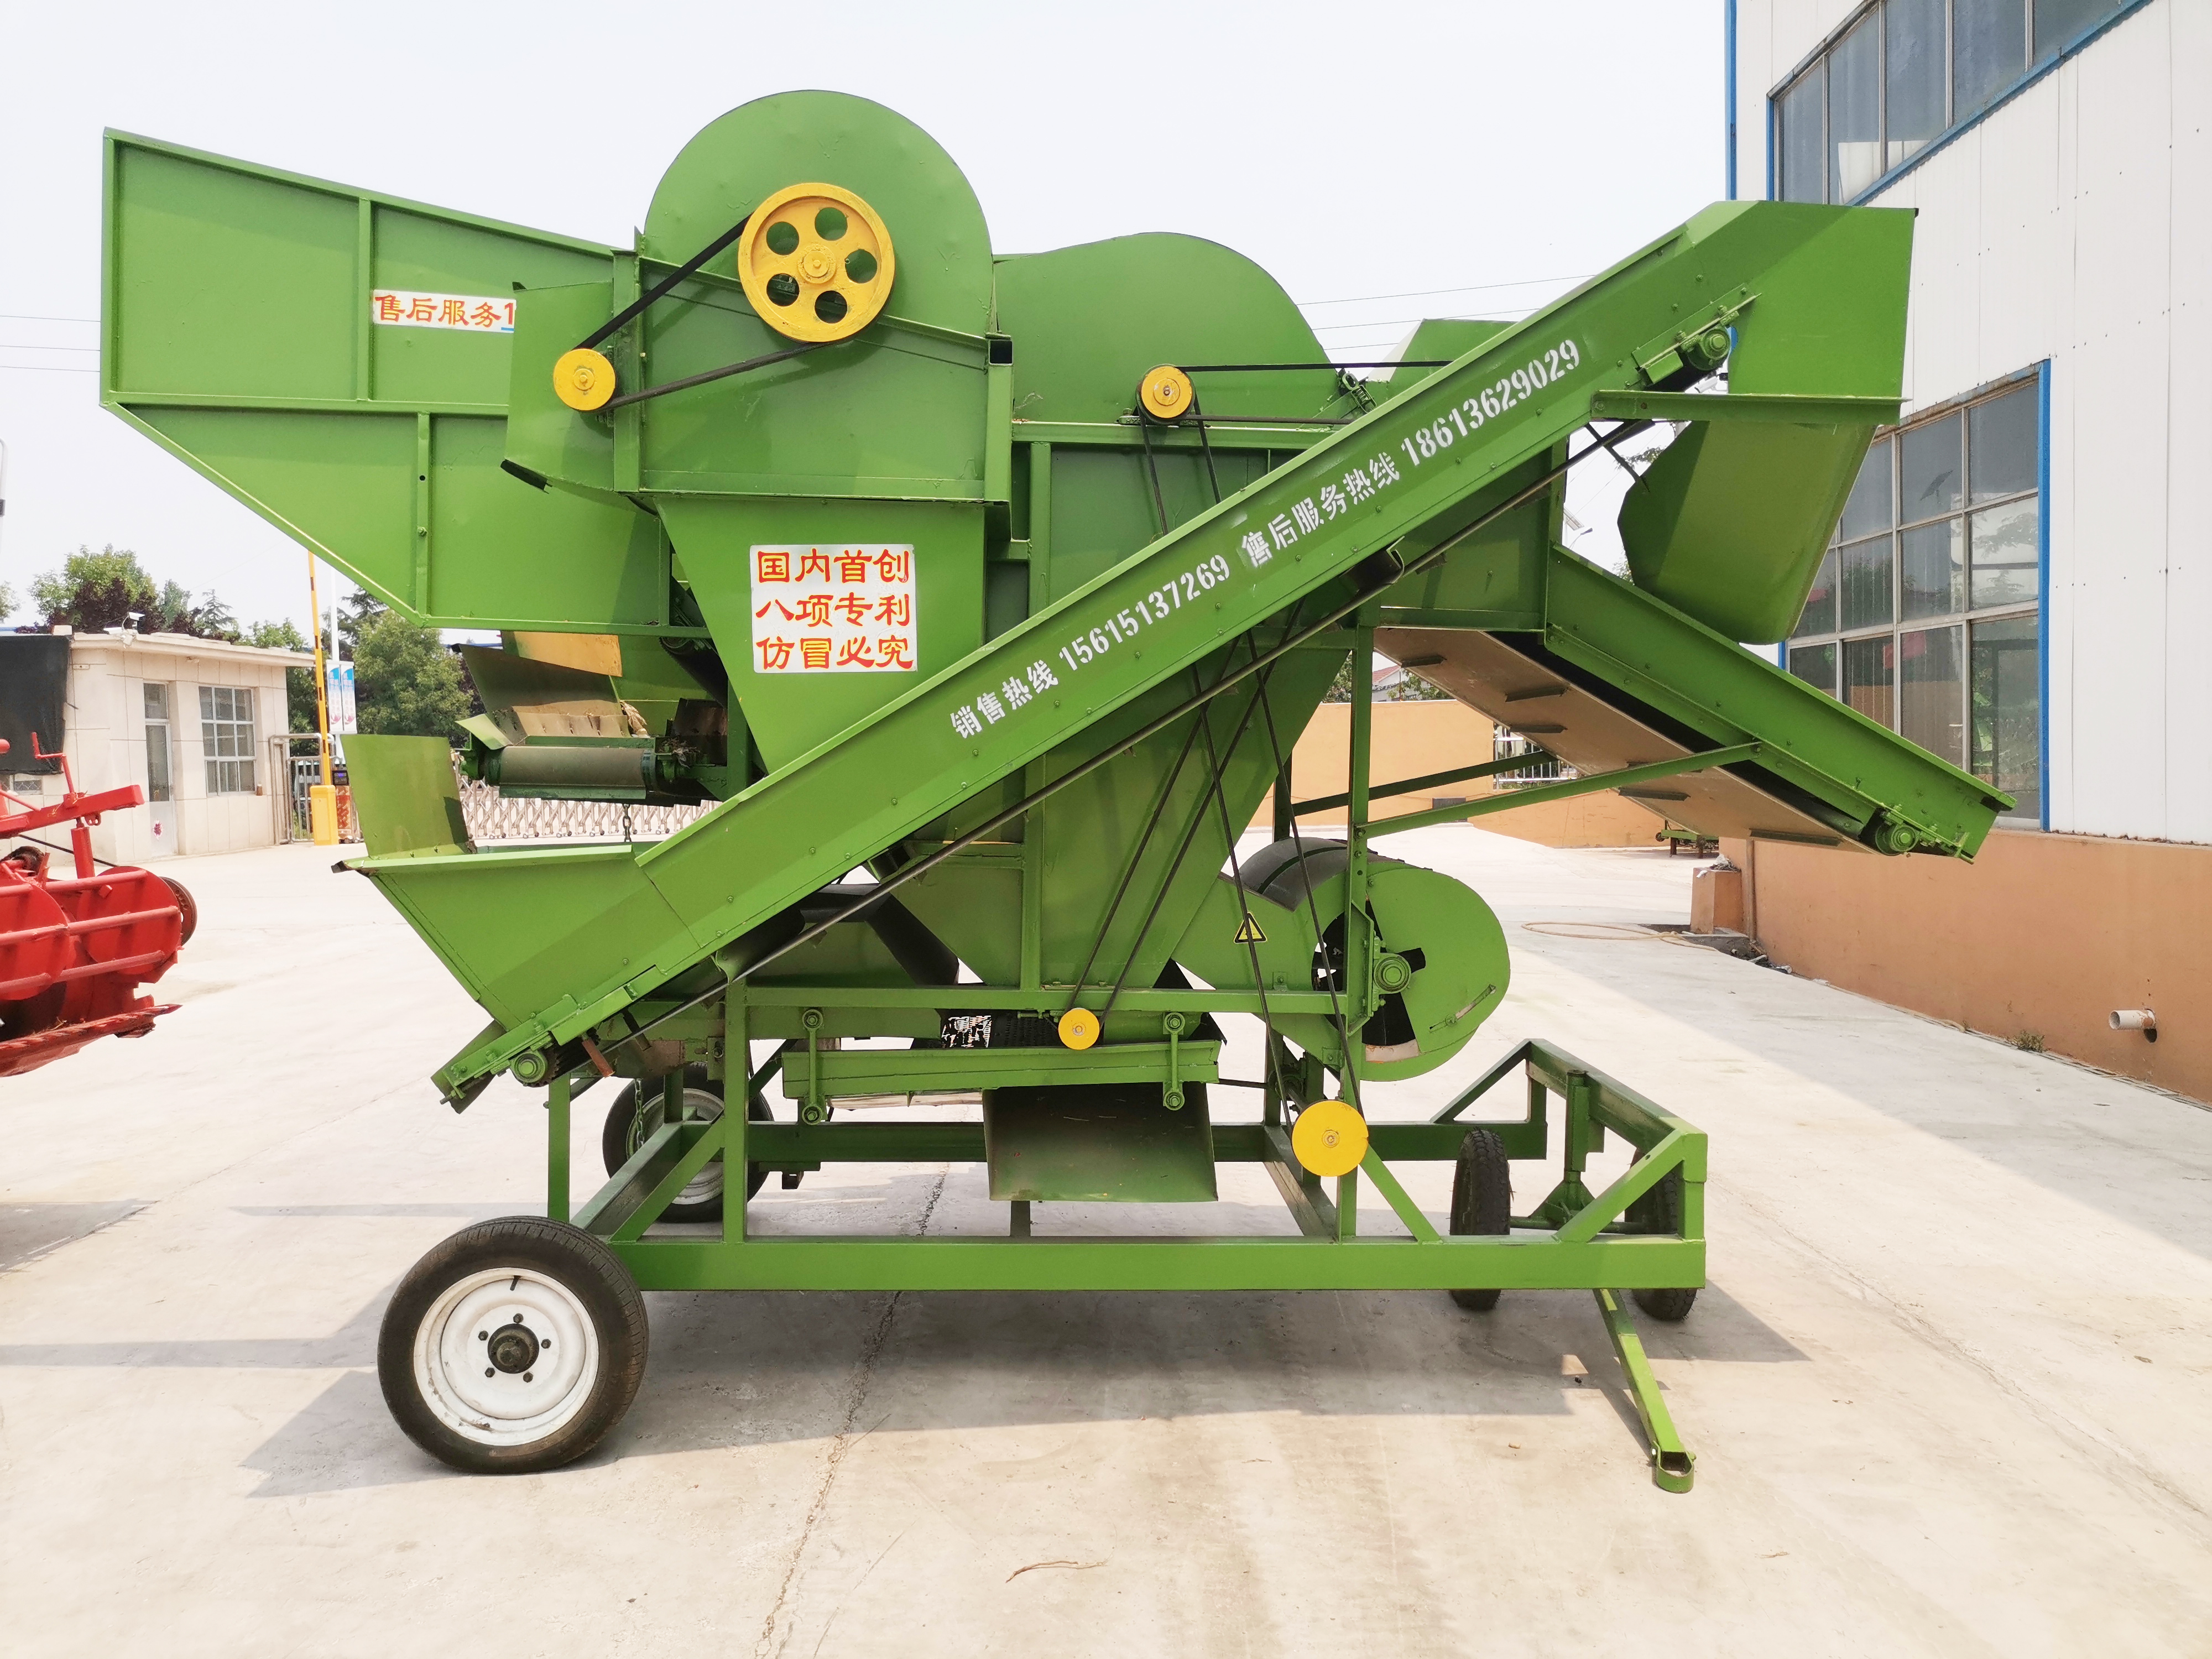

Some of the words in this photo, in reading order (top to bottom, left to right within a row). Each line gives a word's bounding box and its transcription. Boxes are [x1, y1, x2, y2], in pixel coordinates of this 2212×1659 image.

[950, 659, 1058, 738] 销售热线
[1058, 555, 1230, 671] 15615137269
[1241, 452, 1400, 567] 售后服务热线
[1401, 340, 1579, 466] 18613629029
[758, 548, 909, 583] 国内首创
[755, 592, 910, 627] 八项专利
[755, 634, 914, 670] 仿冒必究
